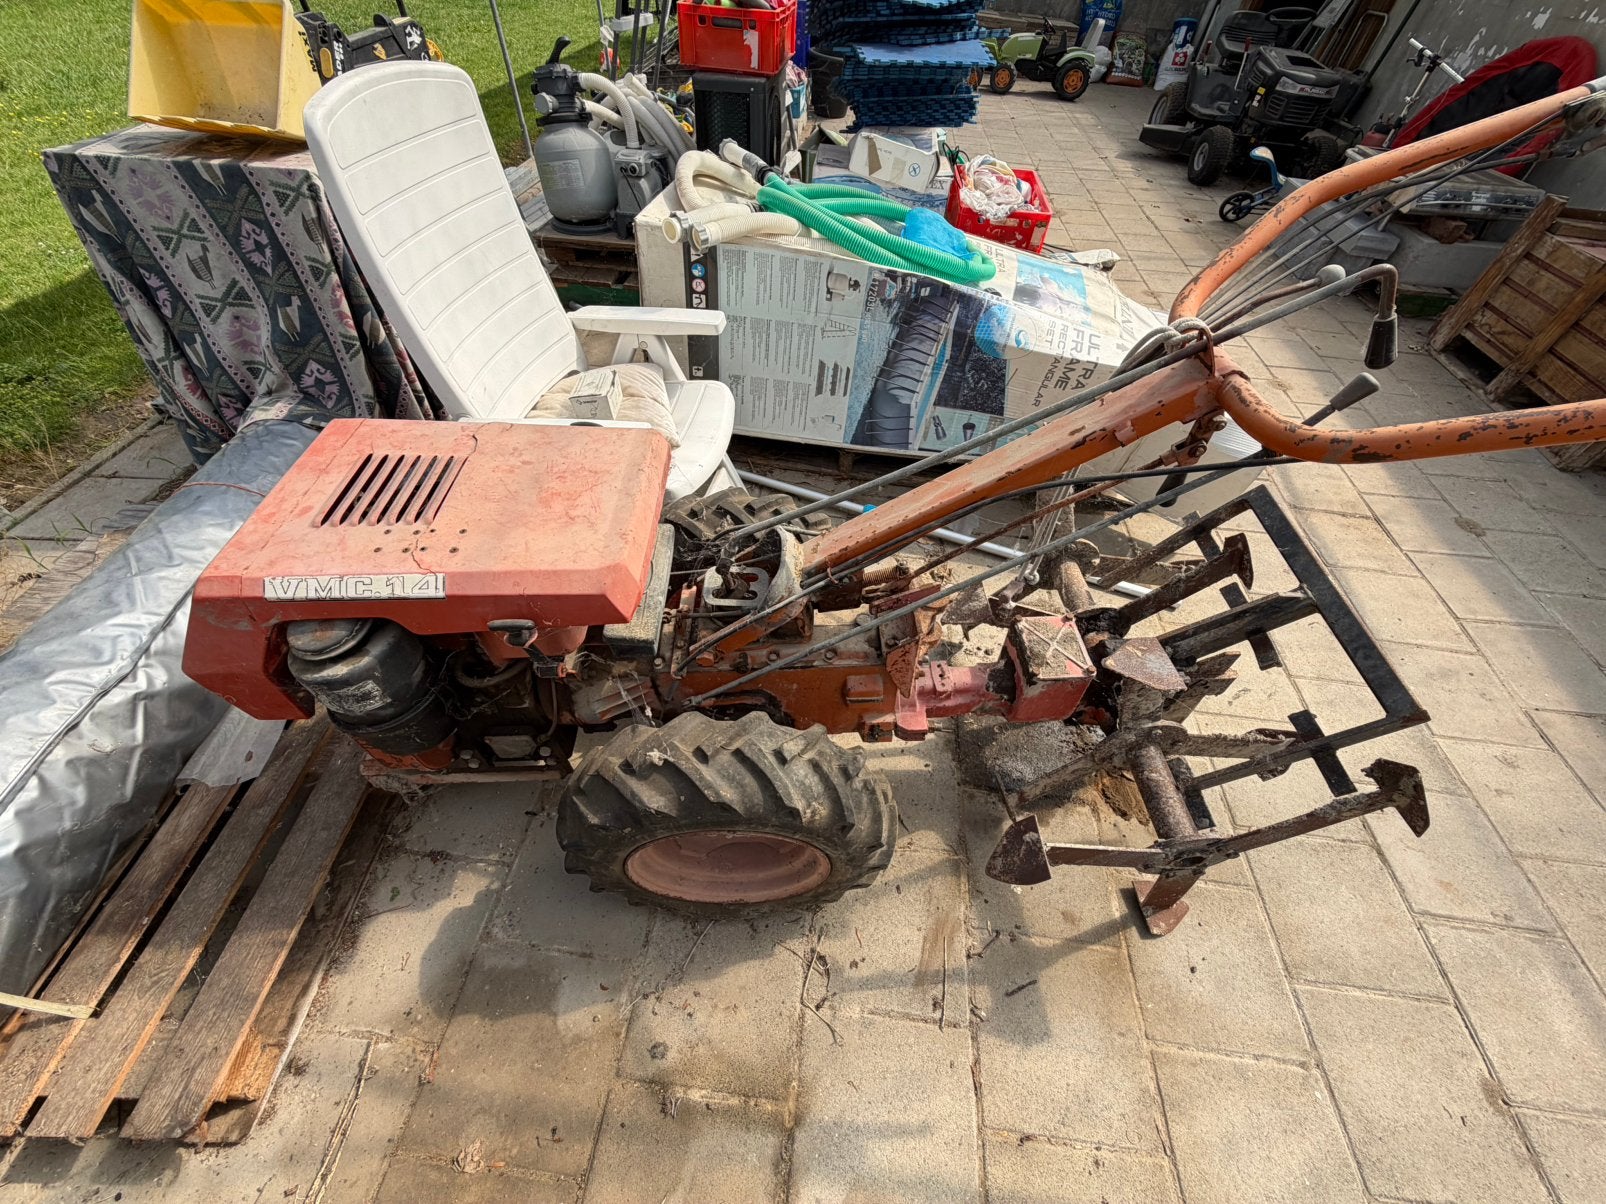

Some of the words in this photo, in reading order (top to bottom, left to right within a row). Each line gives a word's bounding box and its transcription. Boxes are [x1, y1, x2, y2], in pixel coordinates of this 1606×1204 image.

[1044, 320, 1057, 346] SET
[1053, 327, 1085, 391] FRAME
[1071, 333, 1101, 391] ULTRA
[1031, 323, 1069, 408] RECTANGULAR
[269, 574, 442, 600] VMC.14
